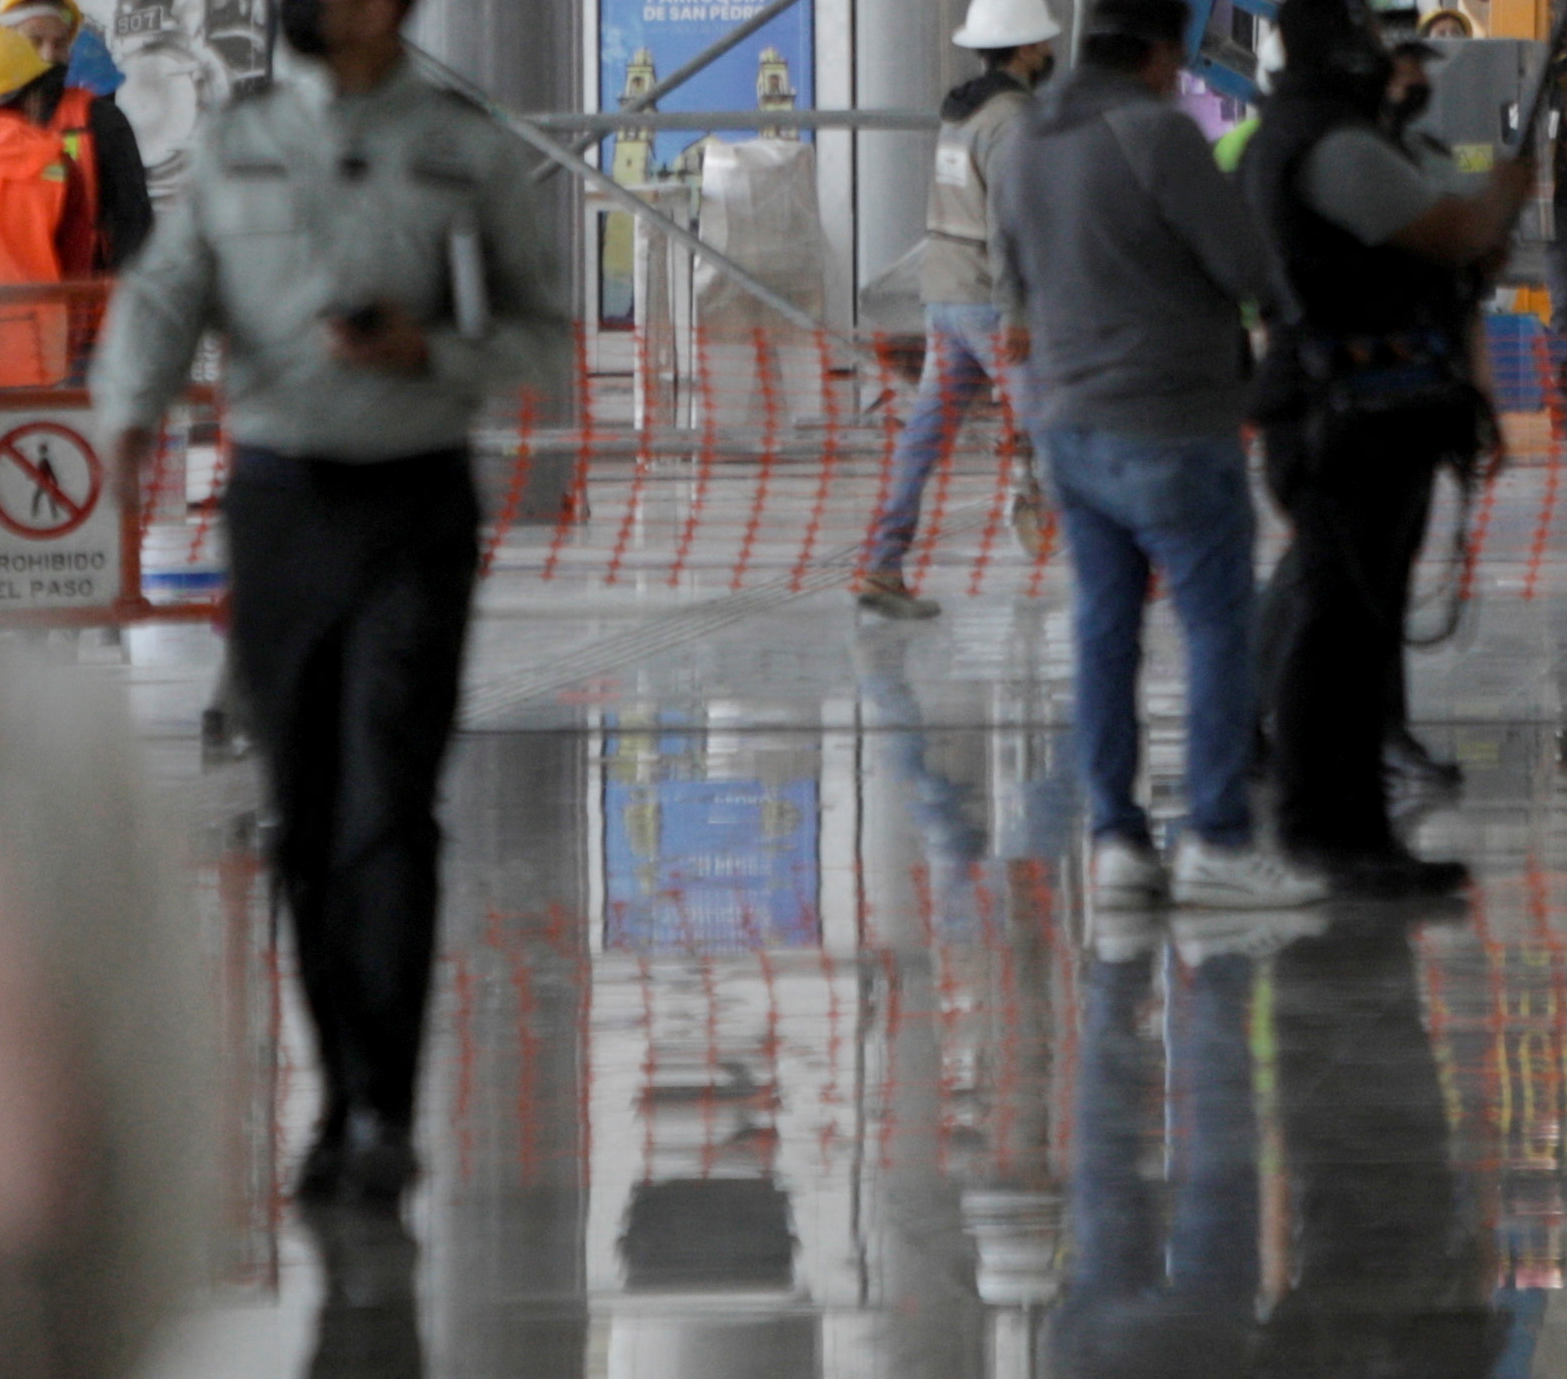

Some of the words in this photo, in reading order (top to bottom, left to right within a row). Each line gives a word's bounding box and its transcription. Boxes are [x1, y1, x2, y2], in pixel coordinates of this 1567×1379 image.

[642, 5, 666, 22] DE
[668, 5, 707, 22] SAN
[29, 579, 94, 598] PASO
